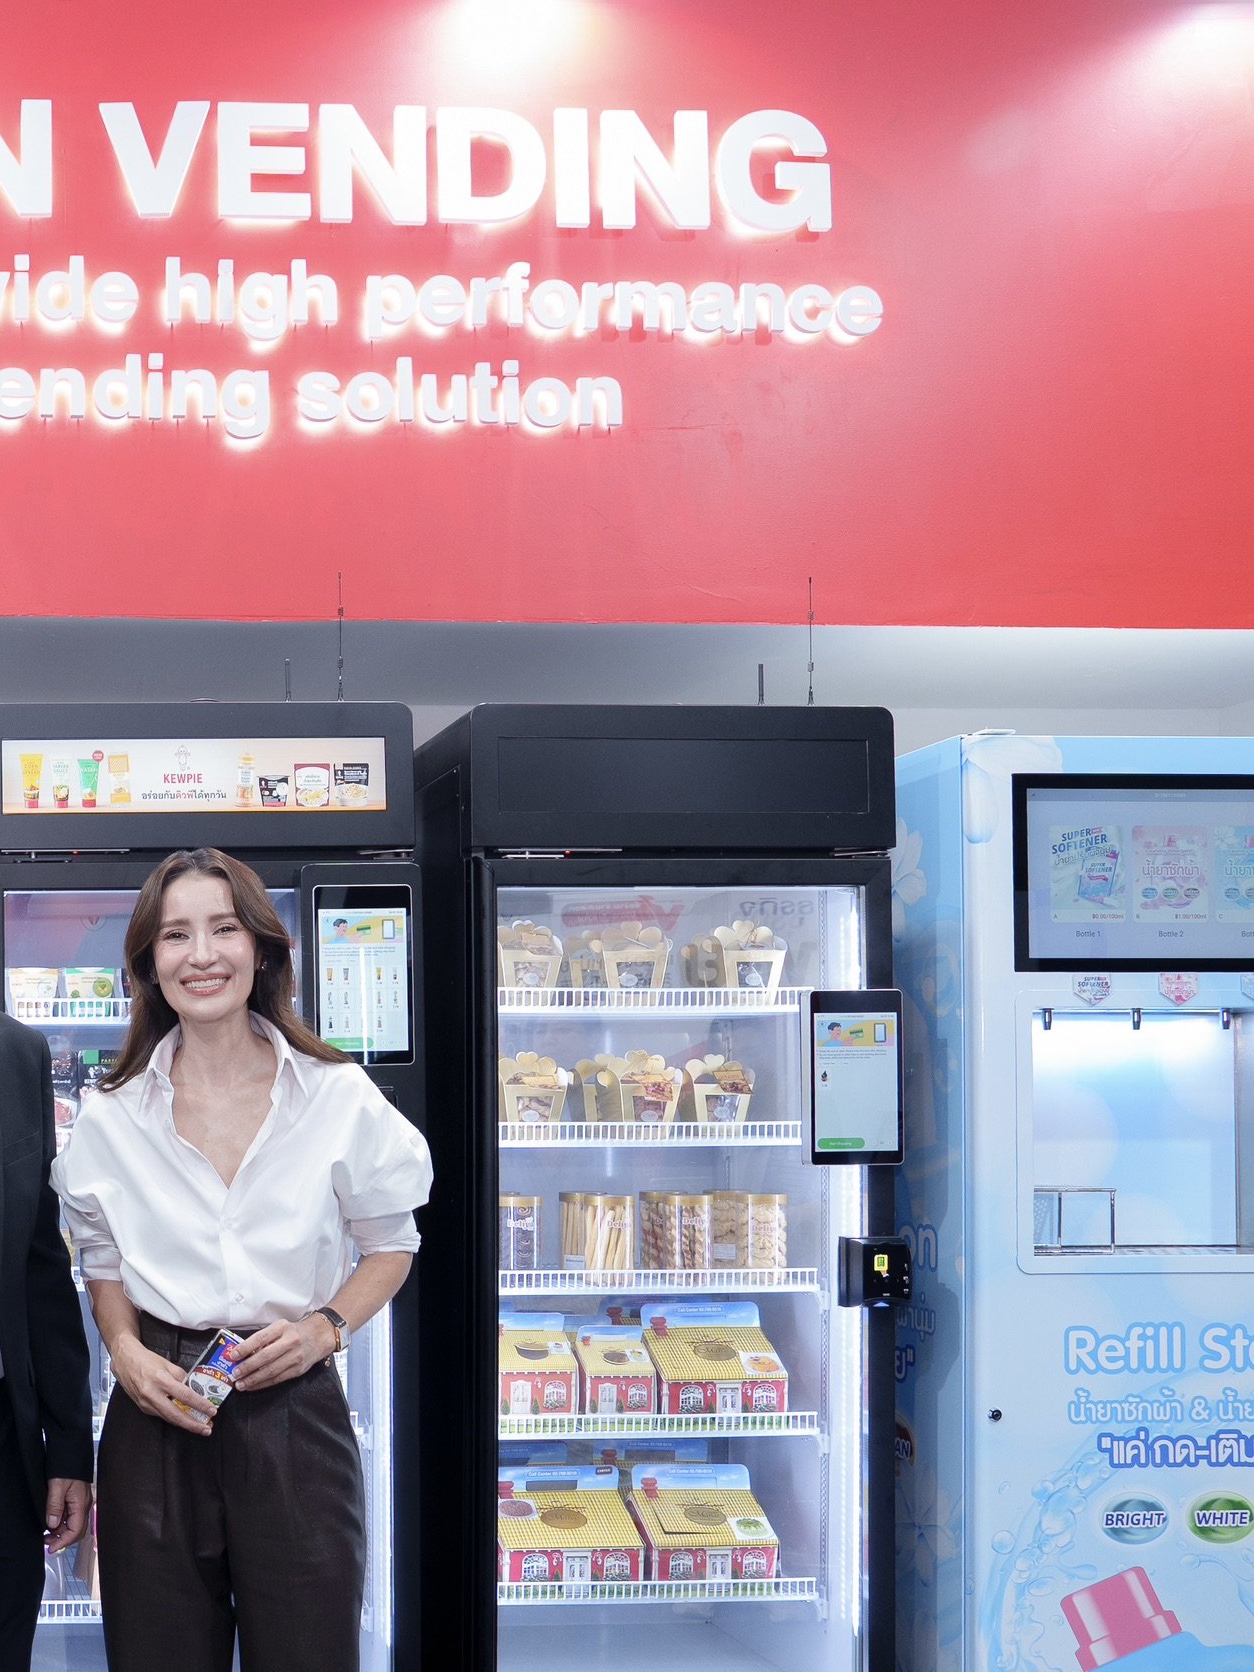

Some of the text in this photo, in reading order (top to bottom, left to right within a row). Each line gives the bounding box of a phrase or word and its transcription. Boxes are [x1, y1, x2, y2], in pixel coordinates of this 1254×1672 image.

[98, 99, 833, 234] VENDING
[164, 255, 338, 340] high
[365, 260, 884, 342] performance
[298, 356, 623, 430] solution
[163, 773, 203, 784] KEWPIE
[1061, 828, 1092, 842] SUPER
[1051, 834, 1107, 854] SOFTENER
[1142, 859, 1200, 876] น้ำยาซักผ้า
[1075, 930, 1096, 938] Bottle
[1158, 930, 1178, 938] Bottle
[1067, 1325, 1183, 1371] Refill
[1069, 1388, 1182, 1422] น้ำยาซักผ้า
[1191, 1398, 1210, 1420] &
[1104, 1512, 1166, 1527] BRIGHT
[1195, 1511, 1249, 1526] WHITE
